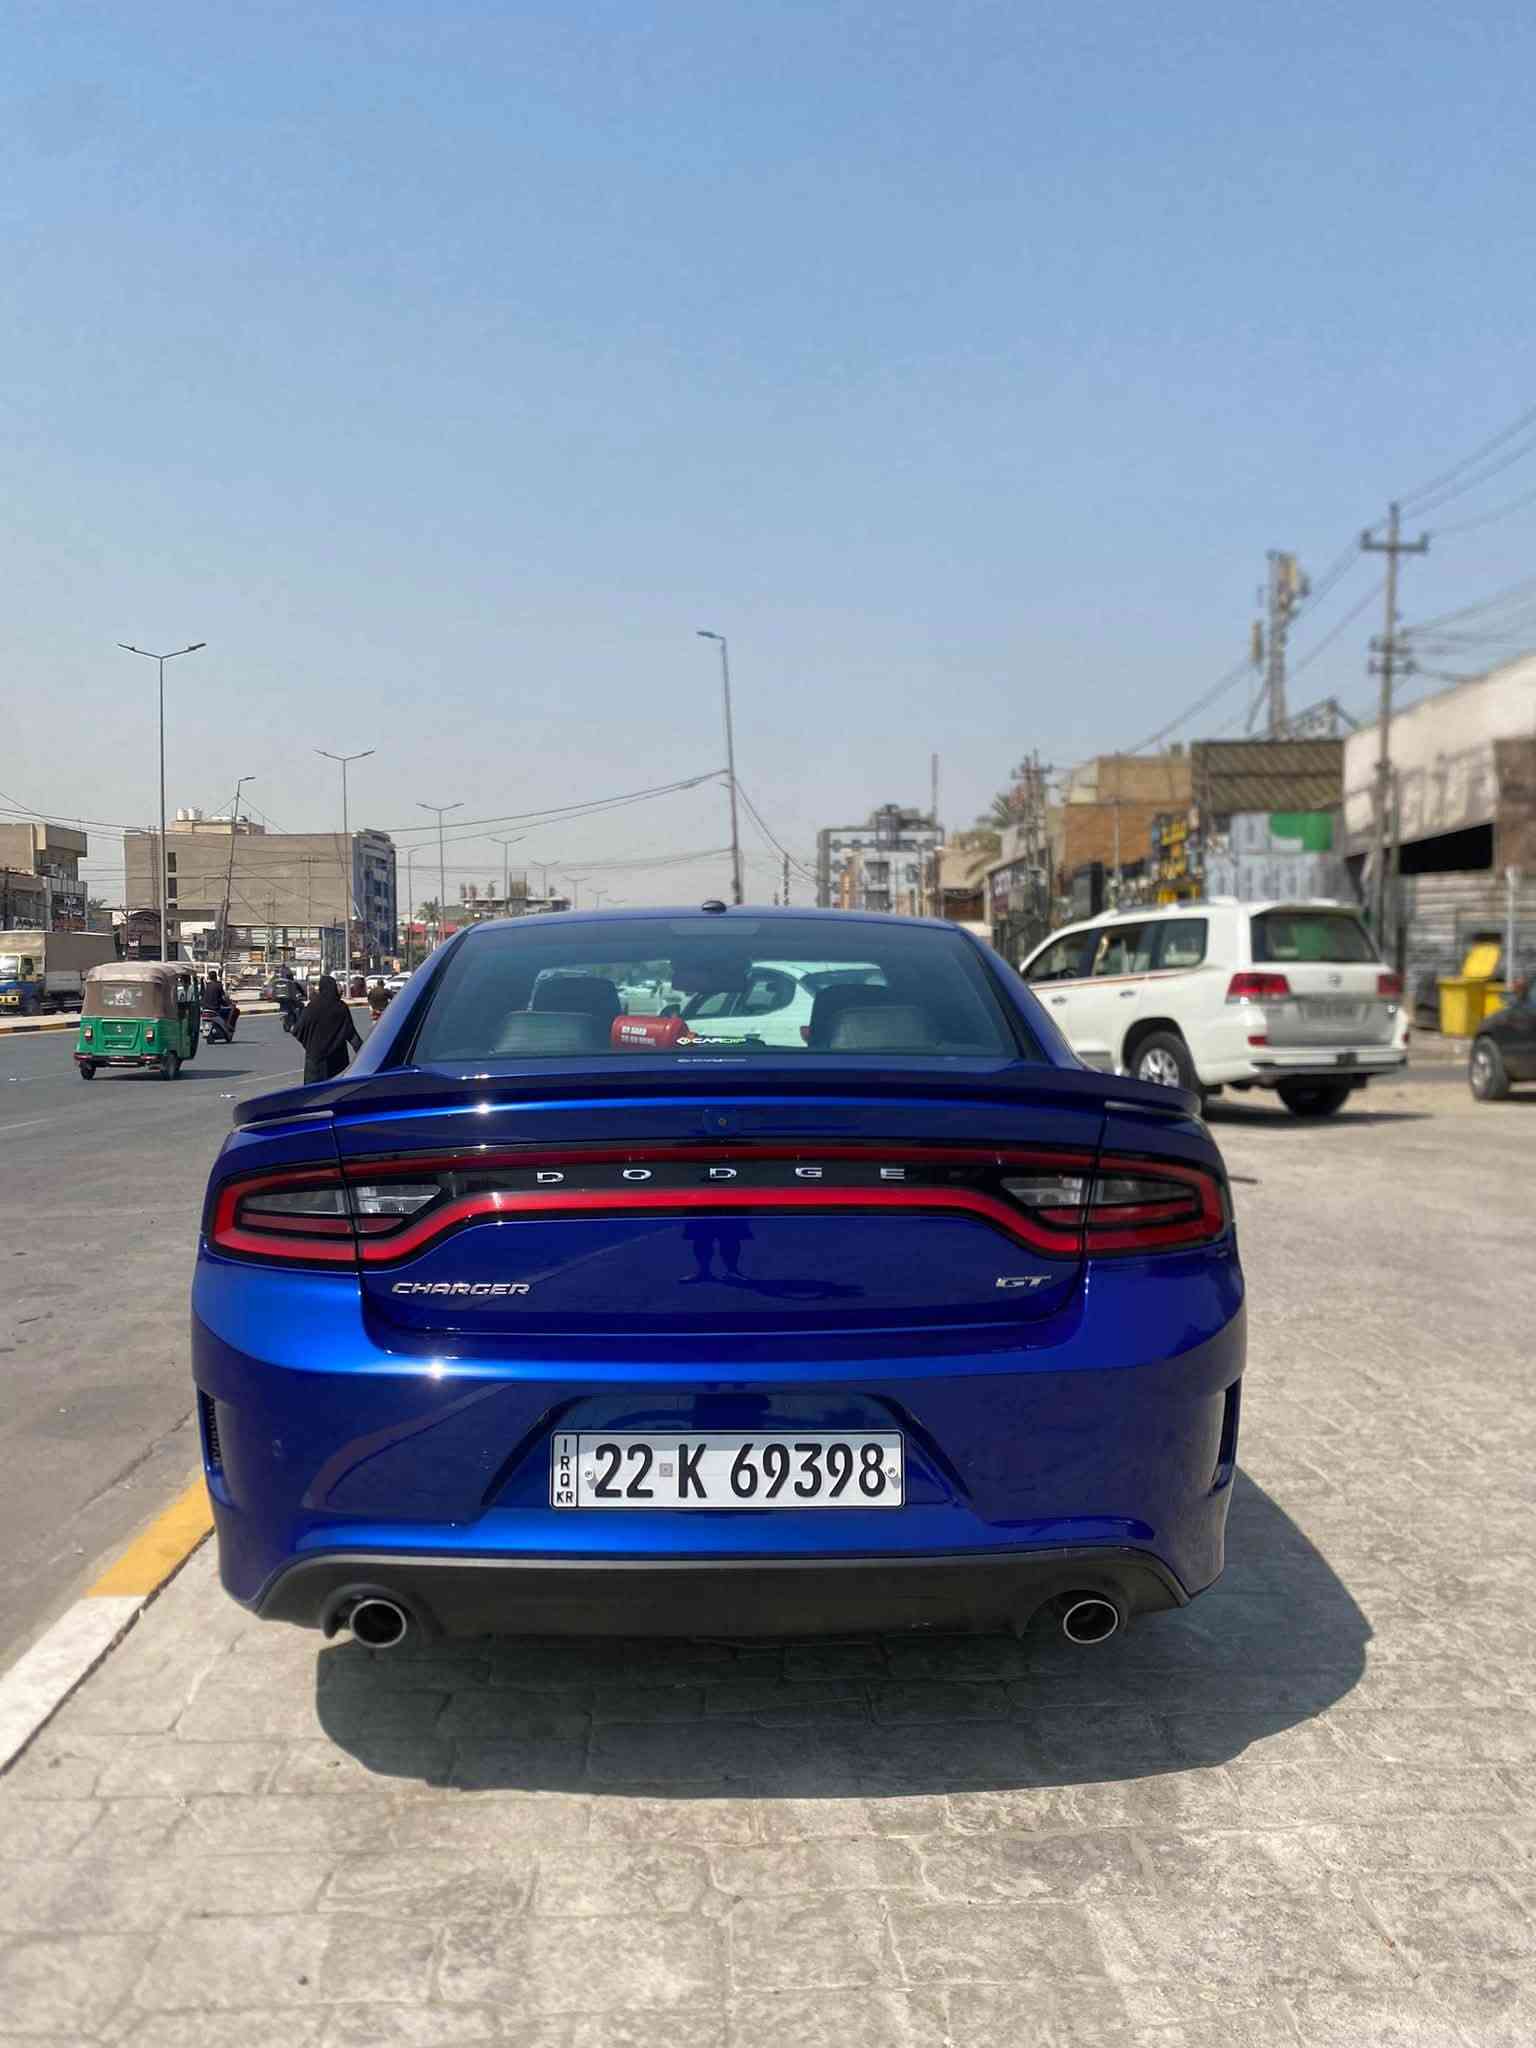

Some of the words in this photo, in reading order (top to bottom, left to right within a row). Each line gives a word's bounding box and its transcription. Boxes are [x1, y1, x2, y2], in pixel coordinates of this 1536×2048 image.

[536, 1168, 905, 1184] DODGE
[995, 1275, 1053, 1288] GT
[391, 1282, 530, 1296] CHARGER
[594, 1443, 654, 1498] 22
[678, 1443, 708, 1498] K
[730, 1443, 887, 1498] 69398
[556, 1490, 573, 1503] KR
